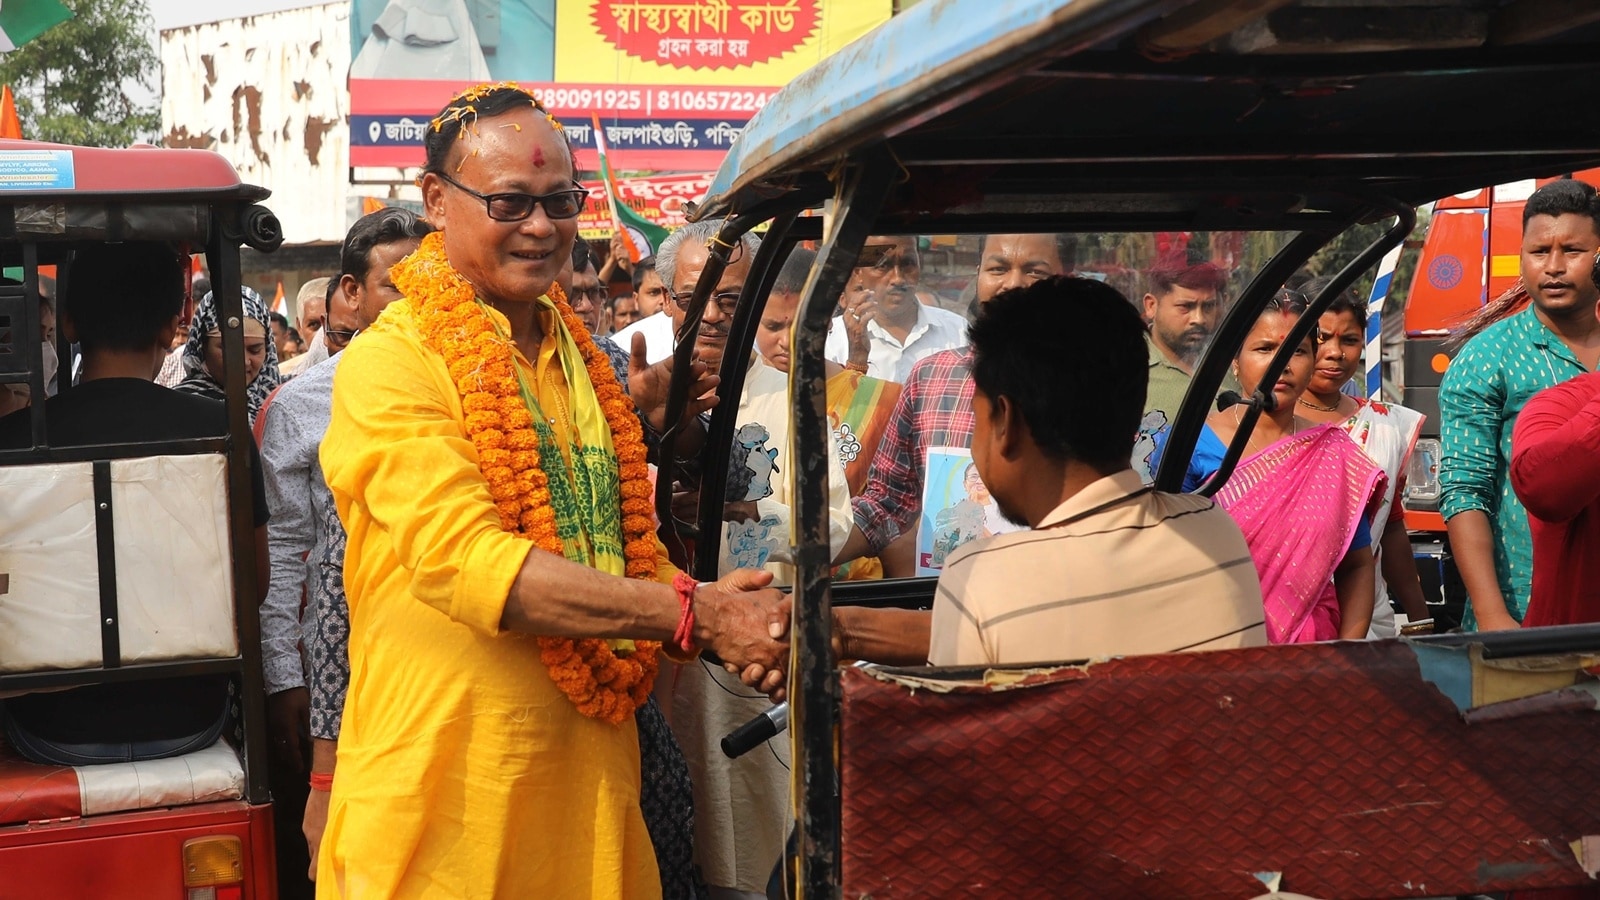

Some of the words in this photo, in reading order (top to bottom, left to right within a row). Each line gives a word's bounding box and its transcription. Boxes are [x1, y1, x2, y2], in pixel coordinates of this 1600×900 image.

[657, 37, 693, 59] গ্রহন
[695, 37, 724, 57] করা
[727, 39, 749, 57] হয়
[657, 90, 776, 110] 810657224
[704, 121, 744, 145] পশ্চি
